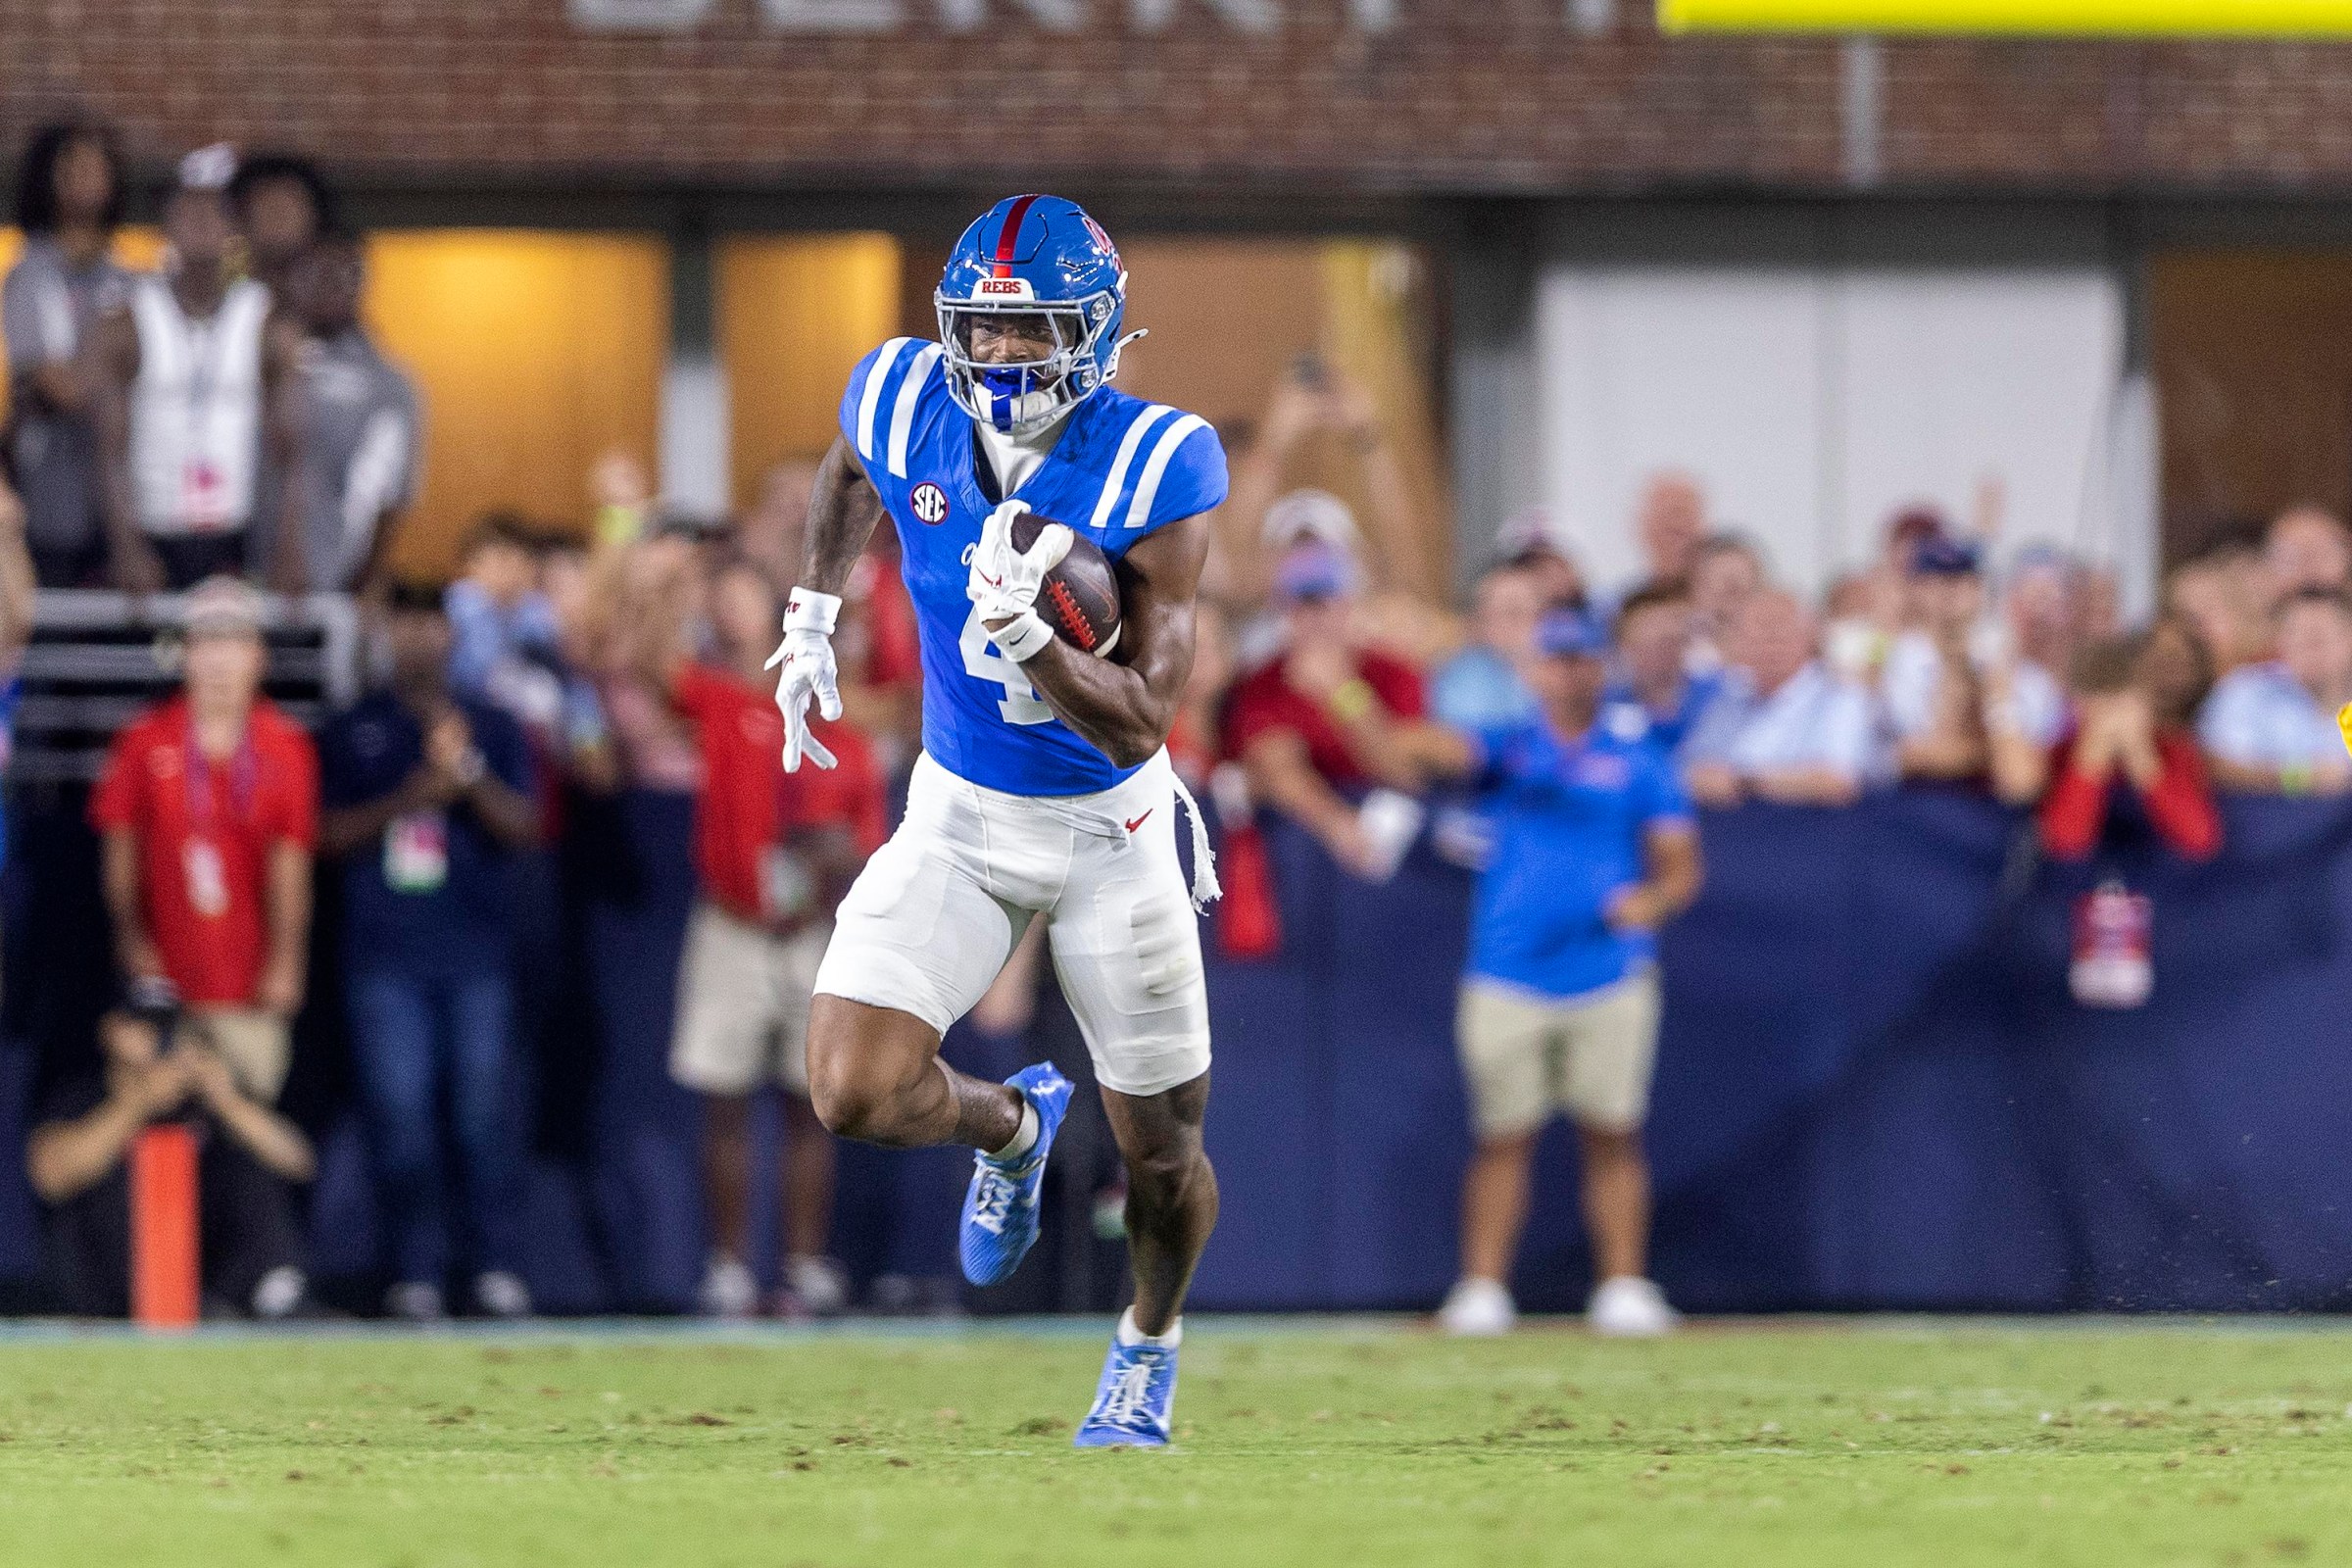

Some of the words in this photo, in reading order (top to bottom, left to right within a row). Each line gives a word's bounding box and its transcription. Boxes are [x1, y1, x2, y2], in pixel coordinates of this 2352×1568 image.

[981, 280, 1021, 294] REBS
[913, 484, 946, 522] SEC
[958, 605, 1055, 725] 4
